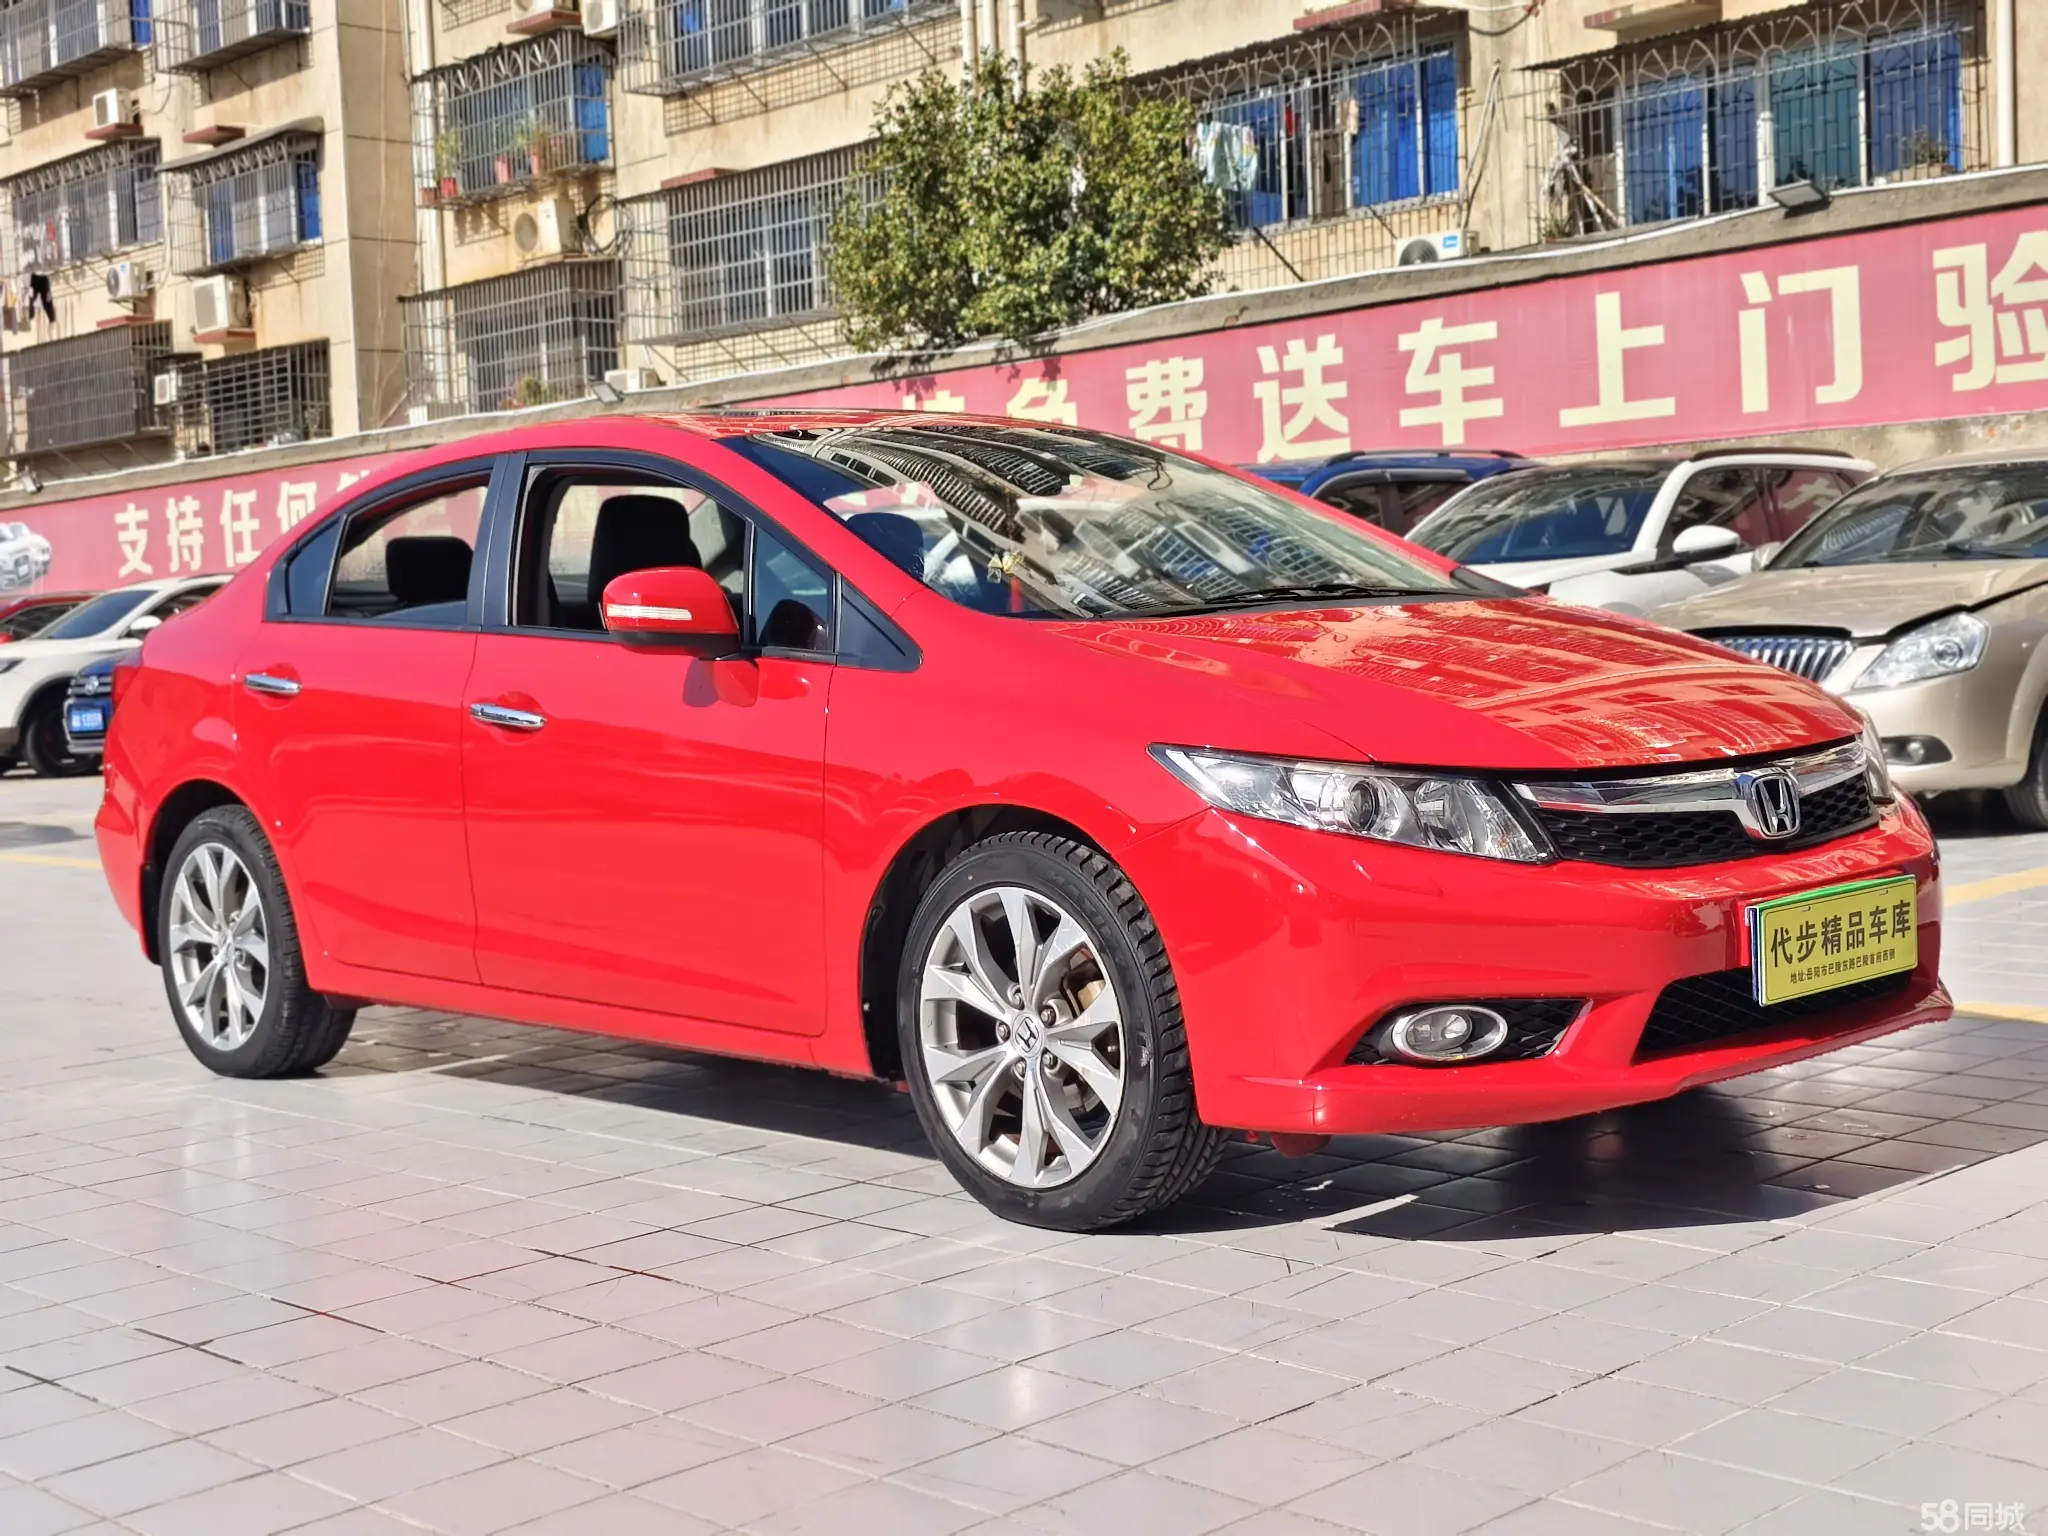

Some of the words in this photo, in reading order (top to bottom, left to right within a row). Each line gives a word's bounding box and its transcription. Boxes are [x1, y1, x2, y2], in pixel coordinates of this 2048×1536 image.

[903, 230, 2048, 464] 费送车上门验
[114, 469, 370, 577] 支持任何
[1771, 900, 1911, 967] 代步精品车库
